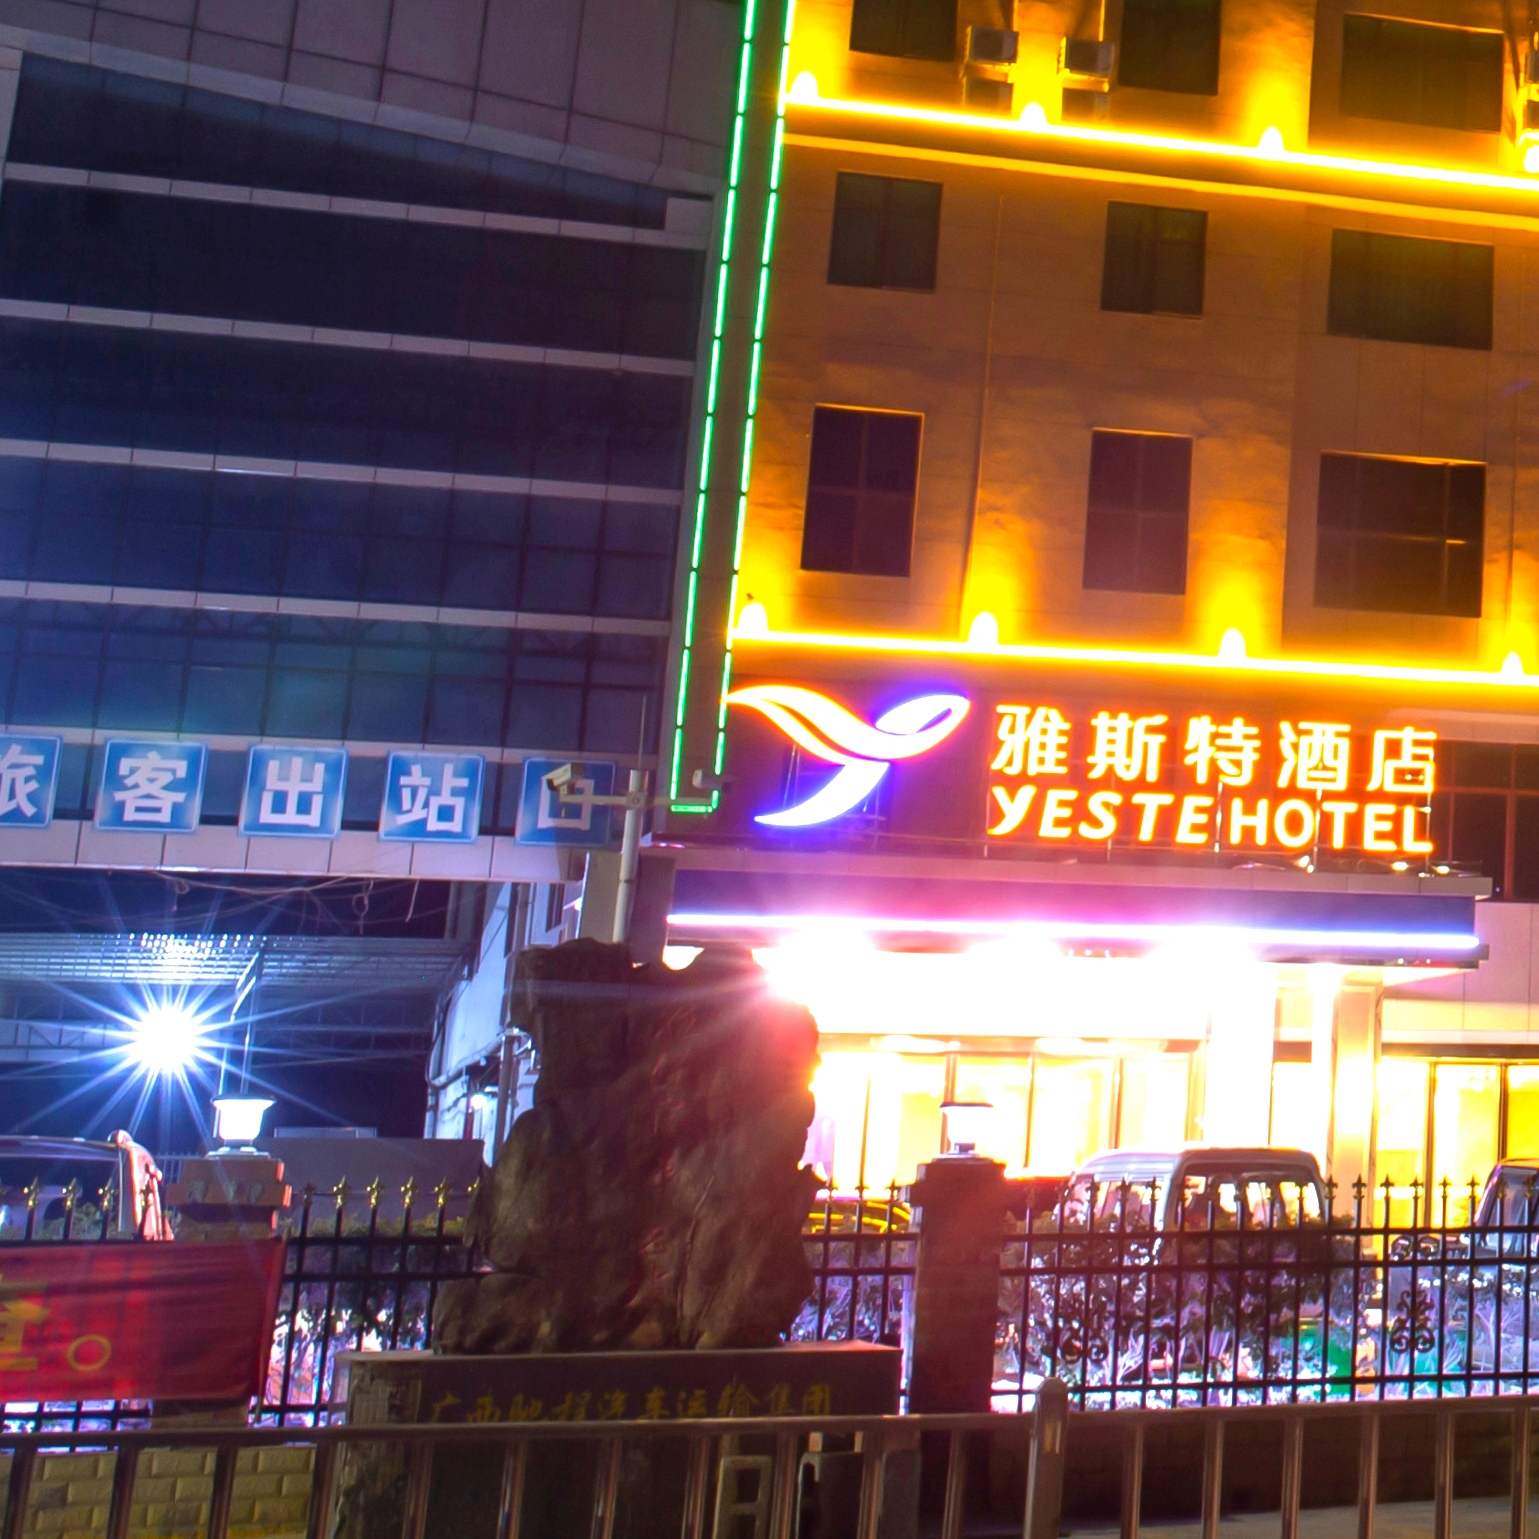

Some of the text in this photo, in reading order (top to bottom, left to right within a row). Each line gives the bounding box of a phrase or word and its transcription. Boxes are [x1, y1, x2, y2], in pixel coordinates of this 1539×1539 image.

[989, 702, 1439, 794] 雅斯特酒店
